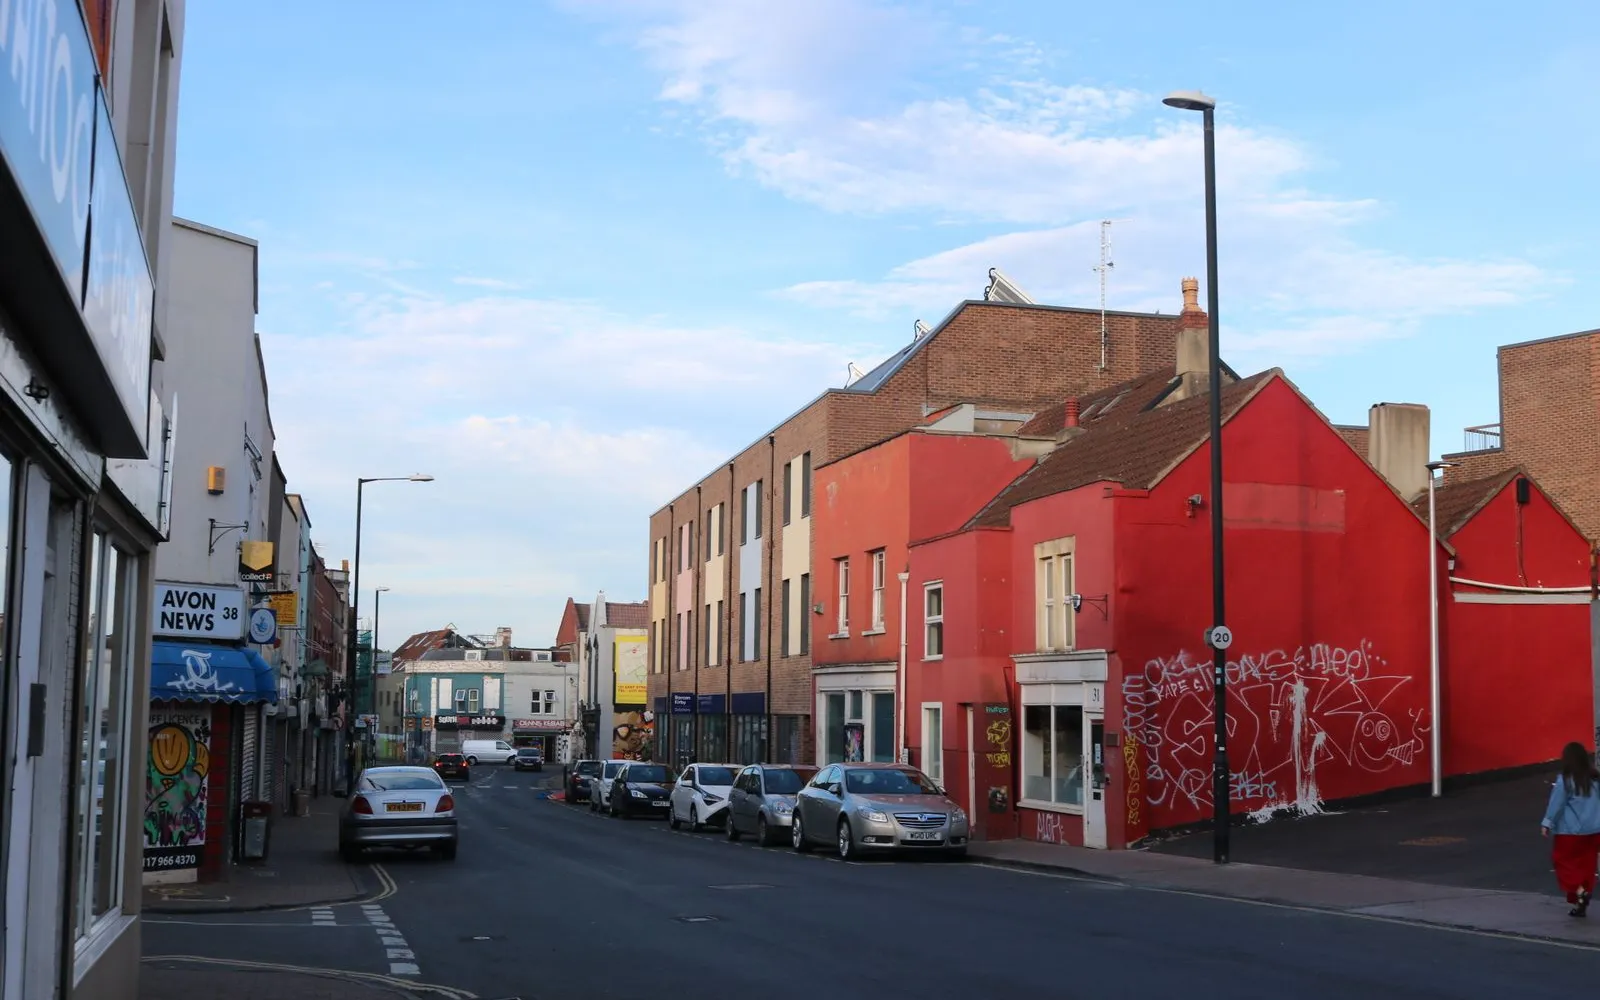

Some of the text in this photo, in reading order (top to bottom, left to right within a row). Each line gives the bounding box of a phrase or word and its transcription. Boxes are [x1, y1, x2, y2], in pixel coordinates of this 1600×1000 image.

[0, 0, 91, 252] ATTOO
[162, 589, 216, 610] AVON
[222, 607, 238, 620] 38
[160, 611, 214, 631] NEWS
[1214, 632, 1230, 643] 20
[1092, 687, 1100, 702] 31
[149, 714, 201, 724] FF LICENCE
[158, 856, 174, 866] 966
[175, 854, 196, 865] 4370
